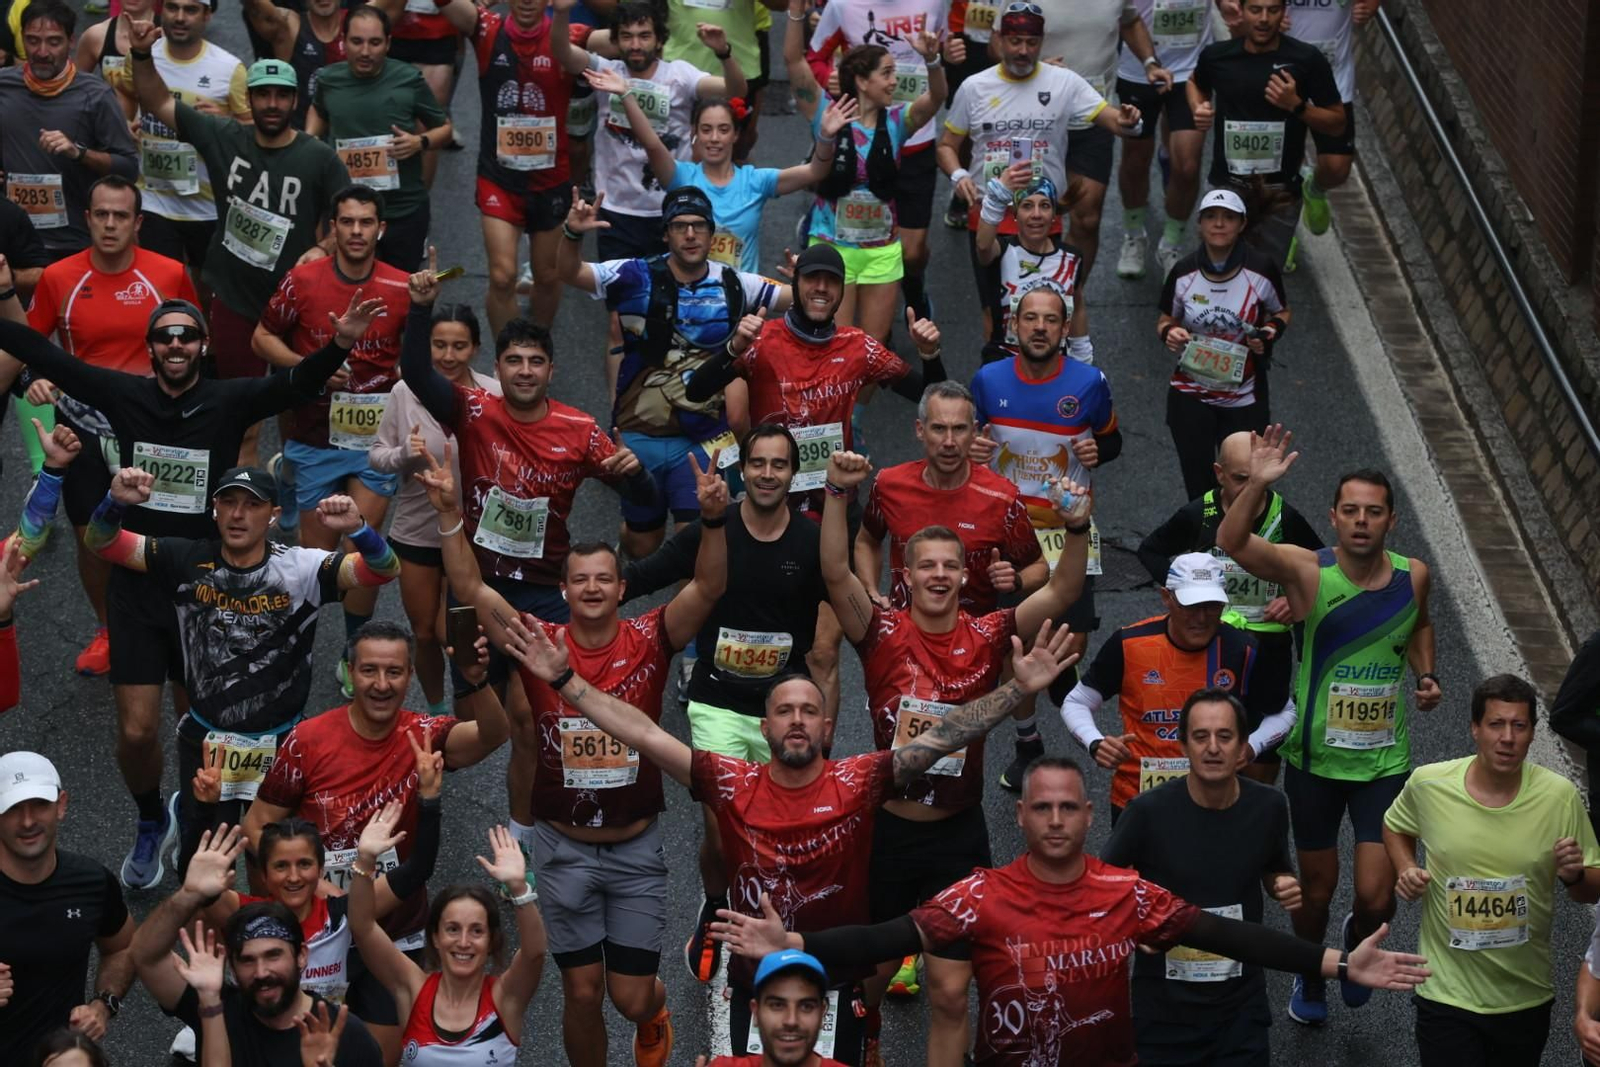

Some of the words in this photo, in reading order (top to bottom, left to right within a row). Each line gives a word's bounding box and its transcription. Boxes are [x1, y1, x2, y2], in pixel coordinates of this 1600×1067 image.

[1161, 13, 1195, 28] 9134
[506, 131, 543, 147] 3960
[1233, 135, 1270, 151] 8402
[148, 154, 182, 171] 9021
[346, 150, 382, 168] 4857
[14, 187, 49, 205] 5283
[235, 213, 272, 242] 9287
[1192, 347, 1232, 373] 7713
[139, 459, 196, 485] 10222
[493, 503, 533, 532] 7581
[724, 645, 779, 668] 11345
[1335, 699, 1389, 720] 11951
[572, 735, 622, 757] 5615
[1453, 895, 1517, 918] 14464
[991, 1000, 1025, 1036] 30
